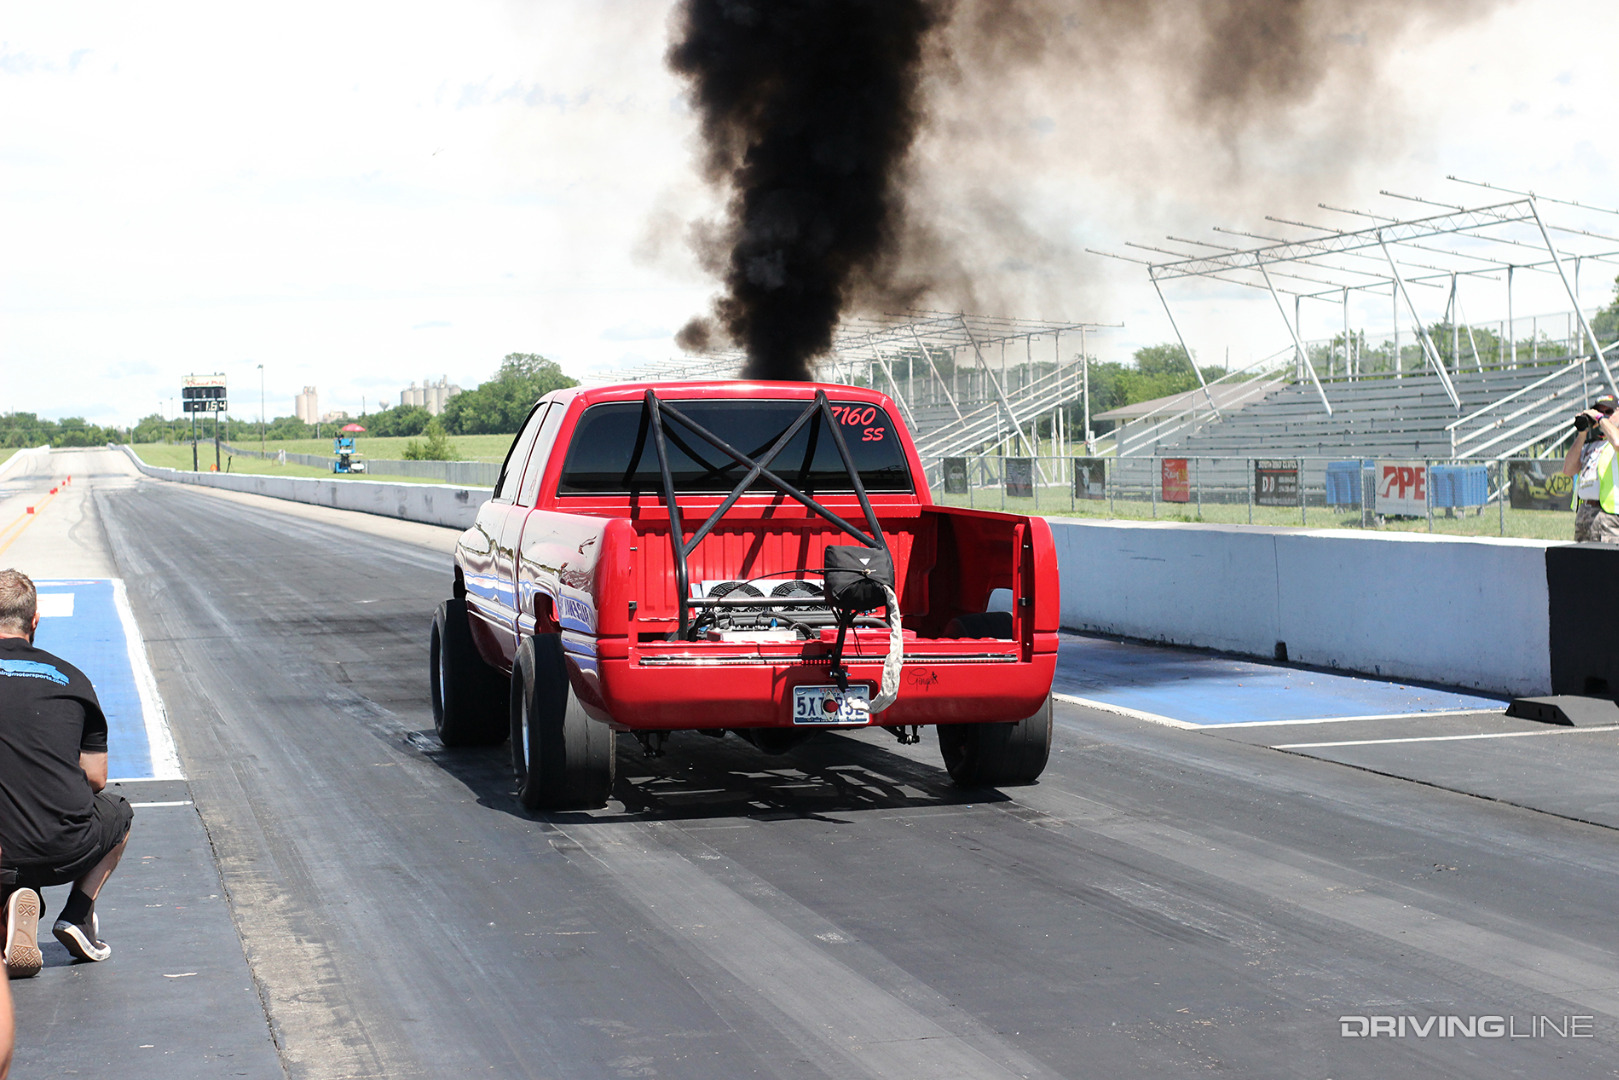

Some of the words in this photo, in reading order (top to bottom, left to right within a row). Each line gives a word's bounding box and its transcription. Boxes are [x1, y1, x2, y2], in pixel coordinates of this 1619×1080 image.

[831, 406, 877, 426] 7160
[862, 427, 885, 442] SS
[1380, 466, 1426, 500] PPE
[1545, 475, 1571, 495] XDP
